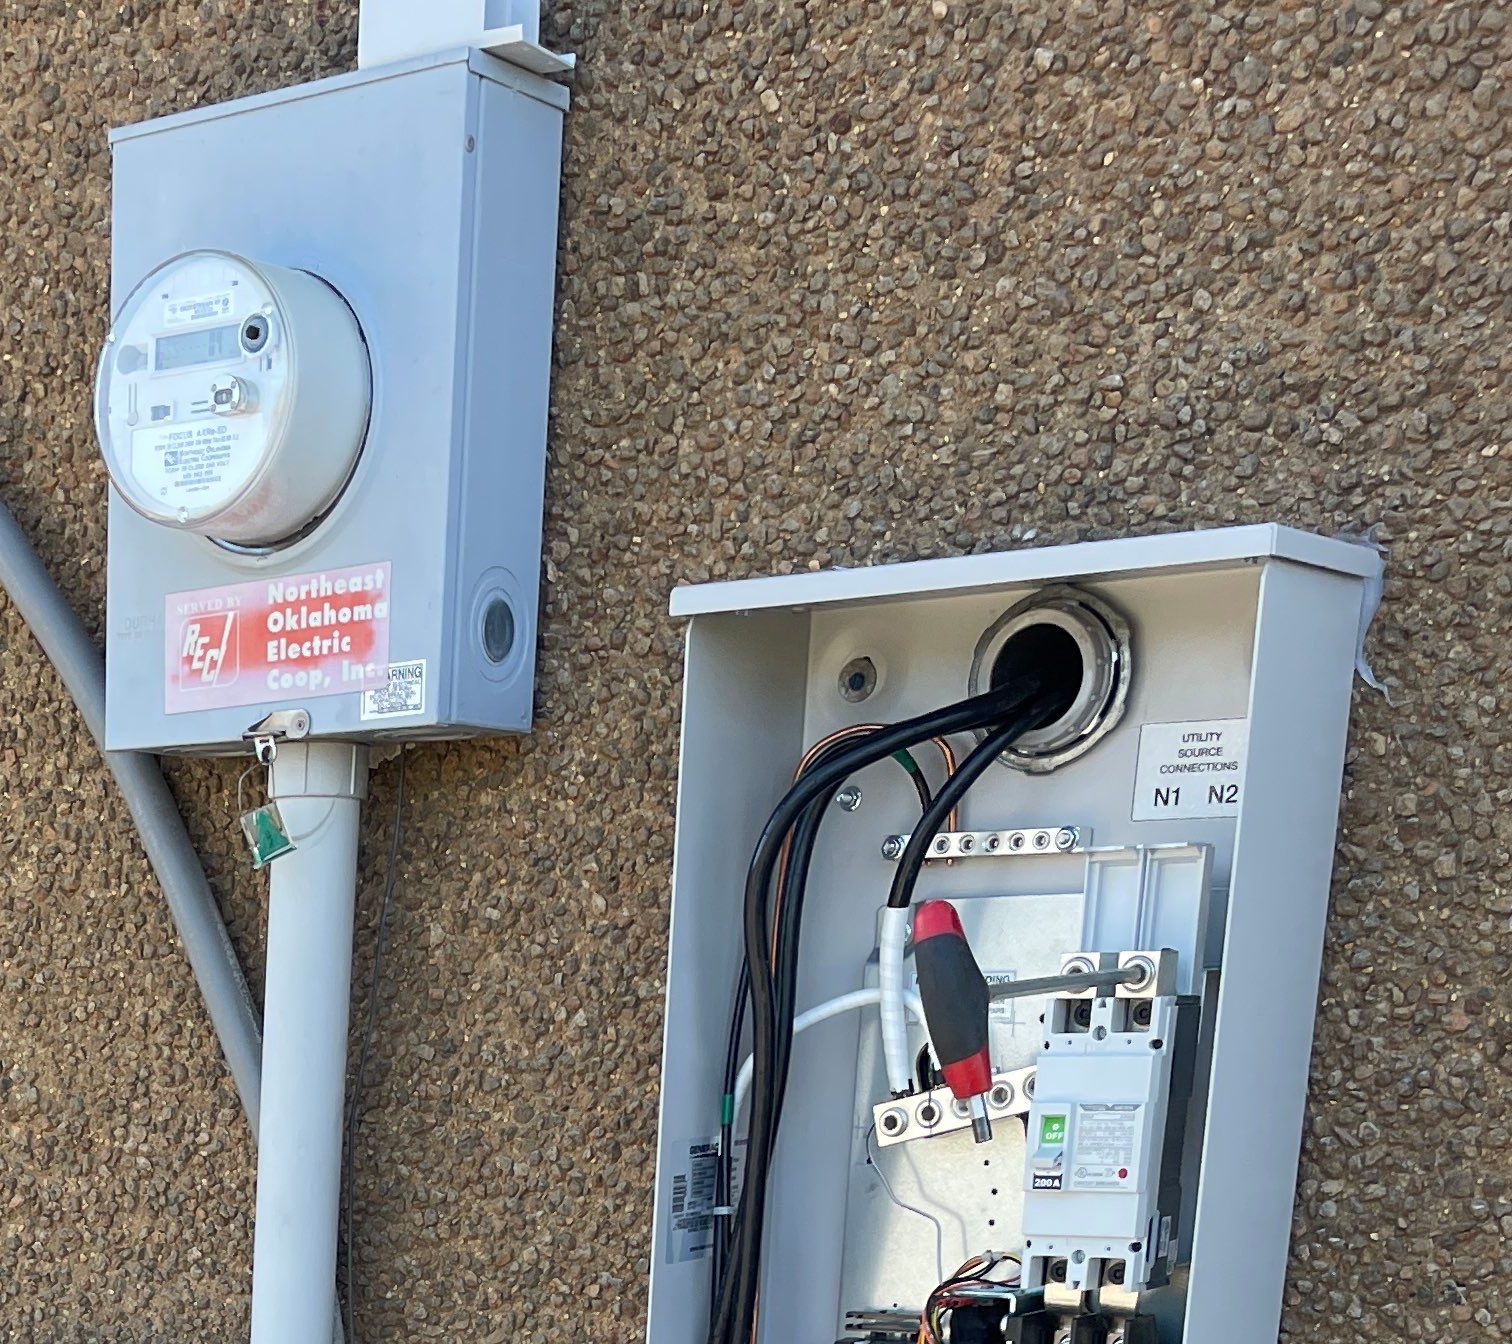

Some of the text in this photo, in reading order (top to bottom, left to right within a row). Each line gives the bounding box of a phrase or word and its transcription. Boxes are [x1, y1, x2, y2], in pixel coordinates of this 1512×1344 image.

[267, 569, 385, 605] Northeast
[176, 596, 242, 614] SERVED BY
[267, 601, 388, 633] Oklahoma
[182, 623, 225, 684] REC
[267, 629, 351, 662] Electric
[266, 660, 384, 691] Coop, Inc.
[388, 665, 423, 680] RNING
[1182, 732, 1223, 743] UTILITY
[1178, 747, 1224, 759] SOURCE
[1159, 761, 1239, 774] CONNECTIONS
[1154, 784, 1239, 807] N1 N2
[1045, 1131, 1064, 1140] OFF
